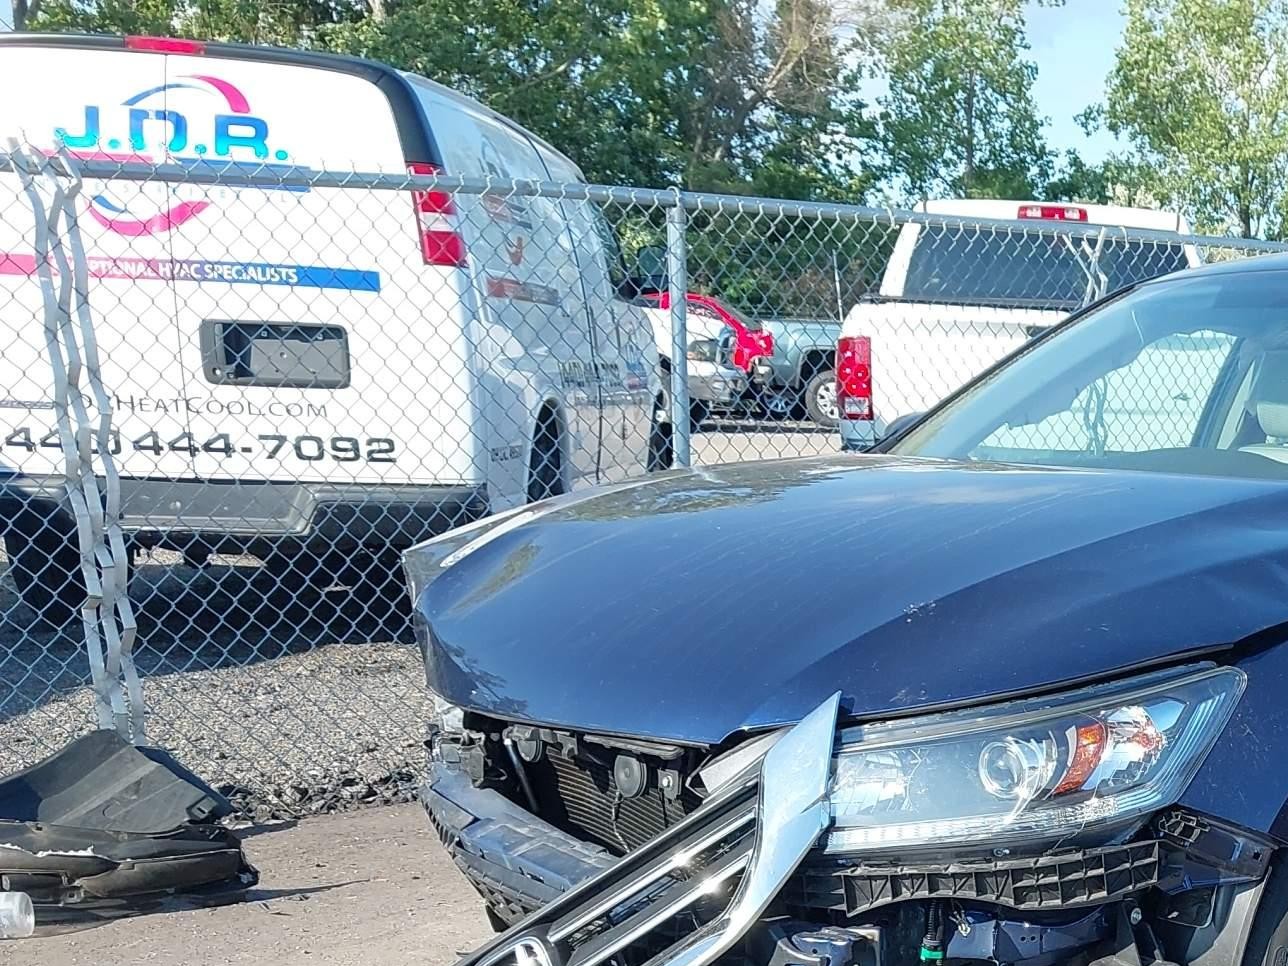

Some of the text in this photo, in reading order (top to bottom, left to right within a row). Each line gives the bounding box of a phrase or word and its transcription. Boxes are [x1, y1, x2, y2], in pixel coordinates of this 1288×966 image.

[54, 105, 289, 160] J.D.R.
[158, 263, 201, 278] HVAC
[204, 264, 298, 283] SPECIALISTS
[132, 430, 397, 463] 444-7092
